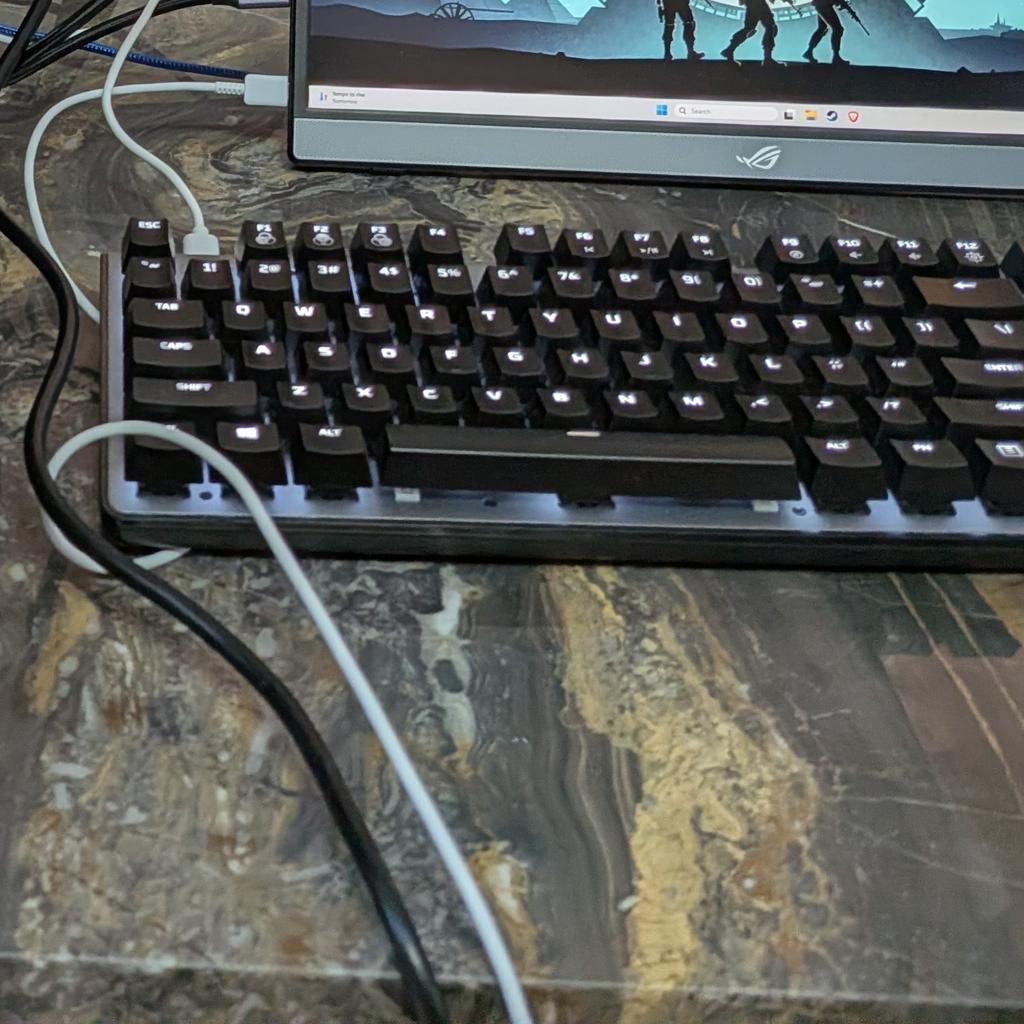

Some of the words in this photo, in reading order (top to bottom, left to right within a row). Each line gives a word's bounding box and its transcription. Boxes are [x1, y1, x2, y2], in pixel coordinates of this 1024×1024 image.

[138, 221, 161, 229] ESC
[256, 224, 272, 232] F1
[313, 225, 330, 233] F2
[429, 228, 446, 236] F4
[518, 227, 535, 236] F5
[576, 232, 593, 241] F6
[634, 233, 650, 242] F7
[692, 235, 710, 244] F8
[781, 237, 799, 246] F9
[837, 238, 861, 248] F10
[897, 240, 920, 249] F11
[956, 242, 979, 251] F12
[155, 302, 180, 311] TAB
[235, 304, 251, 316] Q
[294, 305, 315, 317] W
[358, 307, 373, 318] E
[419, 309, 435, 320] R
[481, 310, 496, 321] T
[542, 311, 558, 323] Y
[605, 313, 622, 325] U
[792, 319, 808, 329] P
[159, 341, 193, 351] CAPS
[255, 344, 272, 356] A
[317, 346, 334, 357] S
[380, 347, 398, 359] D
[444, 349, 458, 360] F
[507, 351, 524, 362] G
[571, 352, 589, 364] H
[638, 353, 652, 366] J
[699, 355, 718, 368] K
[764, 357, 782, 369] L
[175, 382, 213, 392] SHIFT
[291, 385, 309, 396] Z
[355, 386, 374, 398] X
[422, 388, 439, 400] C
[485, 390, 502, 401] V
[551, 391, 571, 403] B
[617, 392, 637, 405] N
[682, 395, 704, 406] M
[995, 401, 1024, 411] SHIF
[318, 428, 343, 438] ALT
[826, 439, 850, 450] ALT
